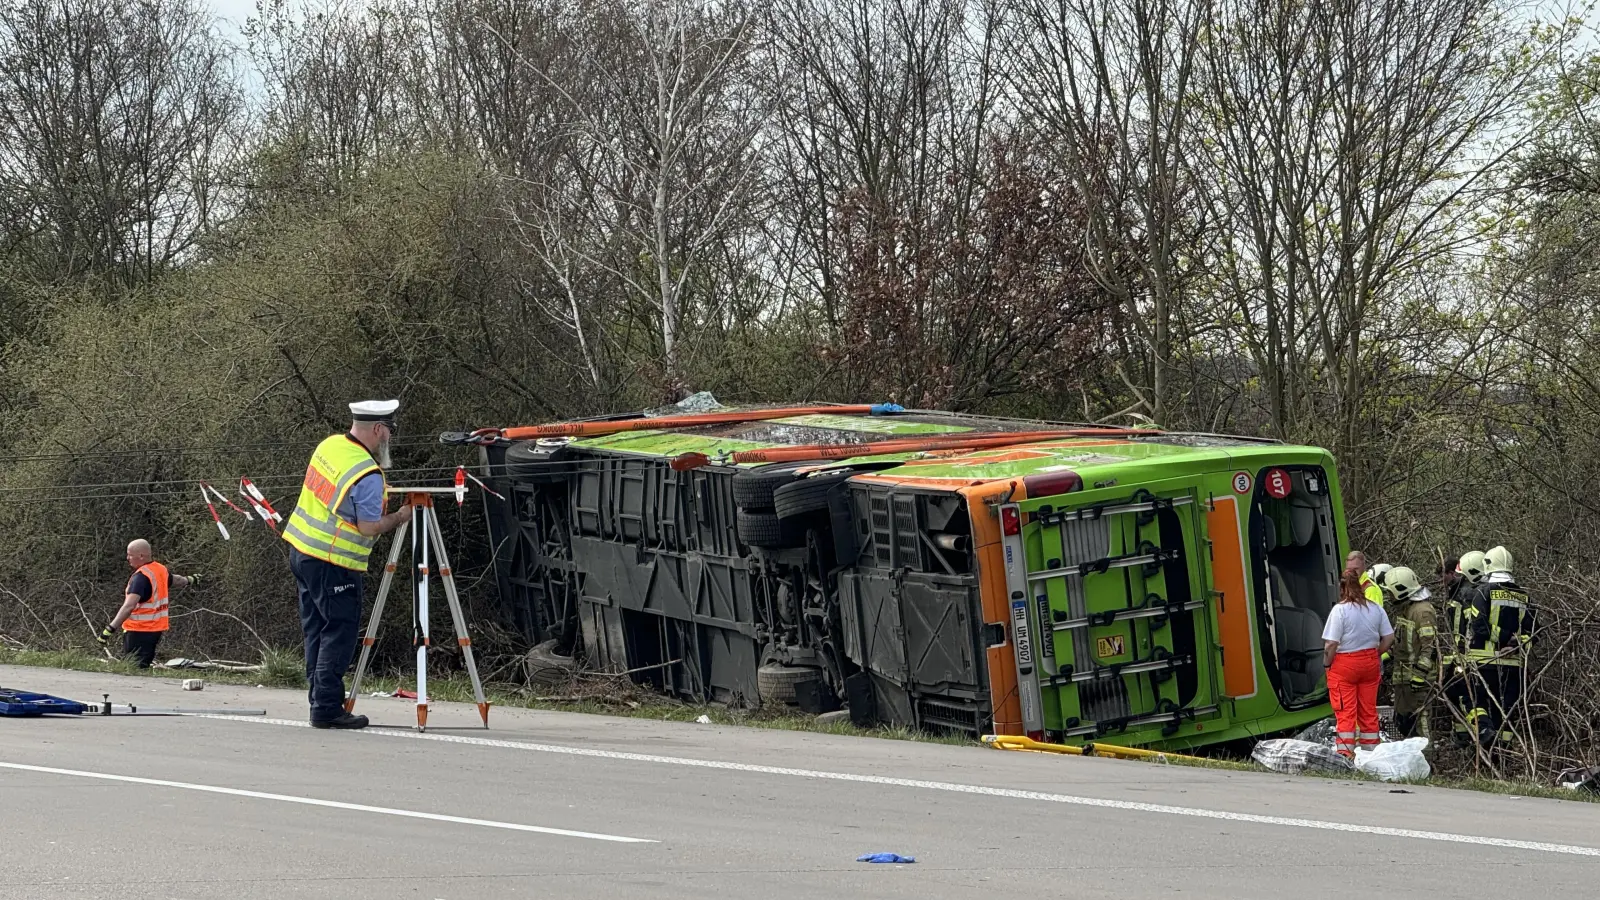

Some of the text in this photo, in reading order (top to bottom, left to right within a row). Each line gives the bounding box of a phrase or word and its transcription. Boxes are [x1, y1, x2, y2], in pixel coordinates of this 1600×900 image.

[1238, 475, 1246, 490] 100
[1271, 470, 1285, 496] 107
[1014, 607, 1030, 661] HH UM 4907
